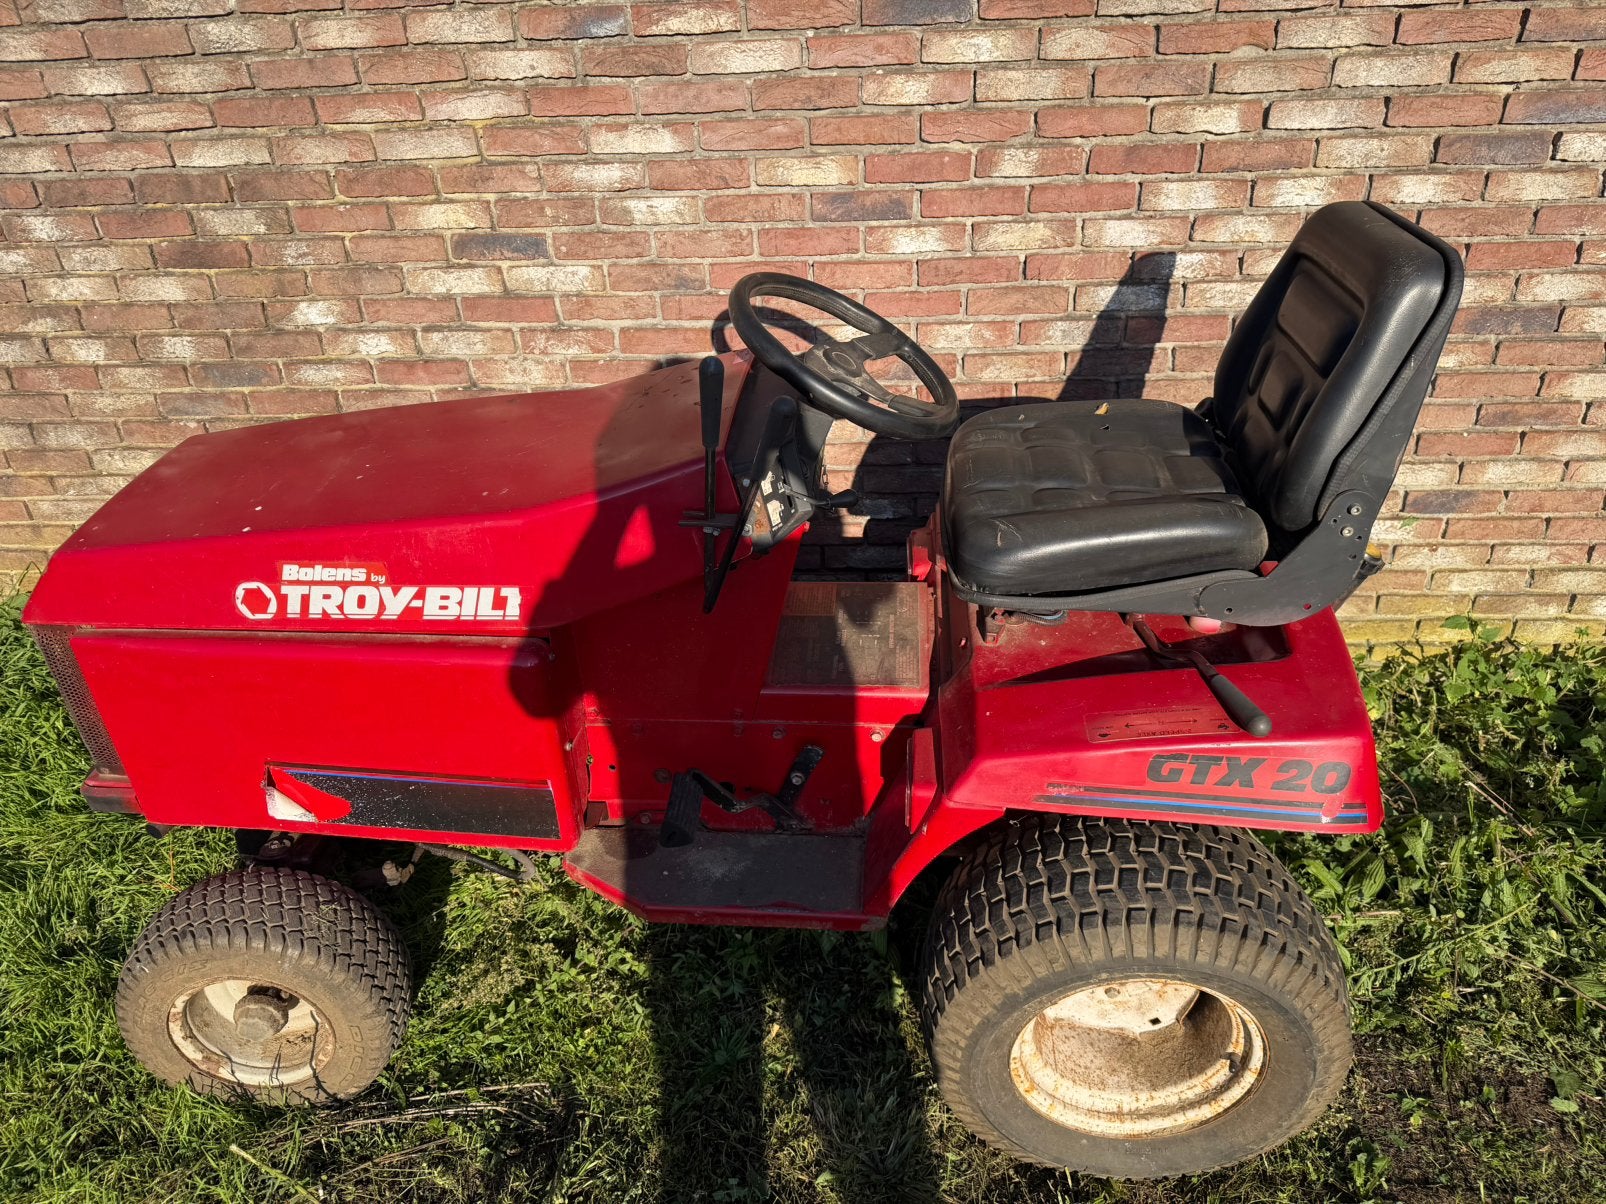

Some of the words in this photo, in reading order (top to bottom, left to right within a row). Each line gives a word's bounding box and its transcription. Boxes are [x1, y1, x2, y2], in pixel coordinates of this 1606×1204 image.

[281, 564, 367, 582] Bolens
[370, 572, 386, 584] by
[280, 585, 522, 620] TROY-BILT
[1147, 753, 1268, 789] GTX
[1270, 759, 1352, 795] 20
